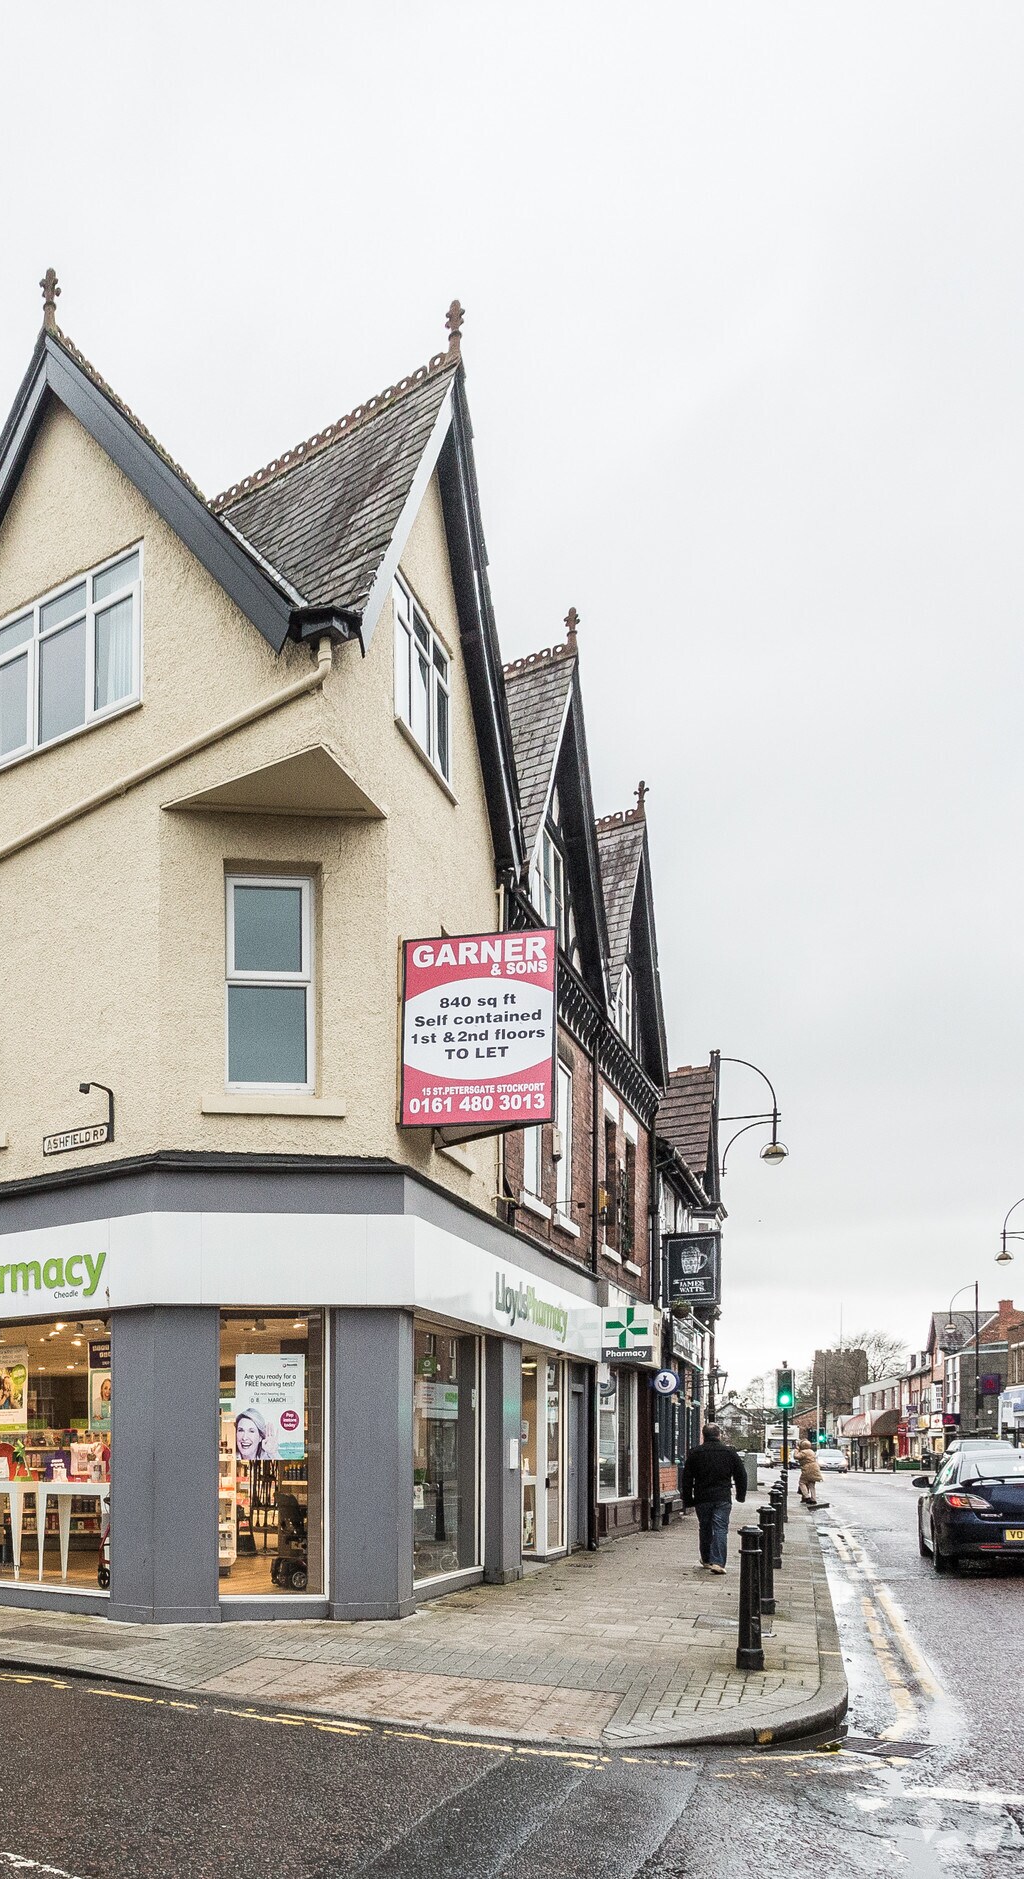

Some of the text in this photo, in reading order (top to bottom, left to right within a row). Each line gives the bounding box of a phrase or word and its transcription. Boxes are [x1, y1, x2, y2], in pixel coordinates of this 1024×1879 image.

[413, 936, 548, 968] GARNER
[490, 960, 548, 976] & SONS
[439, 993, 517, 1009] 840 sq ft
[414, 1009, 542, 1027] Self contained
[411, 1033, 437, 1045] 1st
[495, 1028, 546, 1040] floors
[445, 1046, 509, 1060] TO LET
[422, 1087, 432, 1096] 15
[497, 1083, 545, 1094] STOCKPORT
[409, 1093, 545, 1114] 0161 480 3013
[47, 1131, 91, 1151] ASHFIELD
[679, 1280, 705, 1288] JAMES
[53, 1289, 79, 1300] Cheadle
[495, 1271, 568, 1344] LloydsPharmacy
[605, 1350, 648, 1363] Pharmacy
[260, 1380, 282, 1389] hearing
[282, 1380, 296, 1388] test?
[266, 1373, 282, 1381] ready
